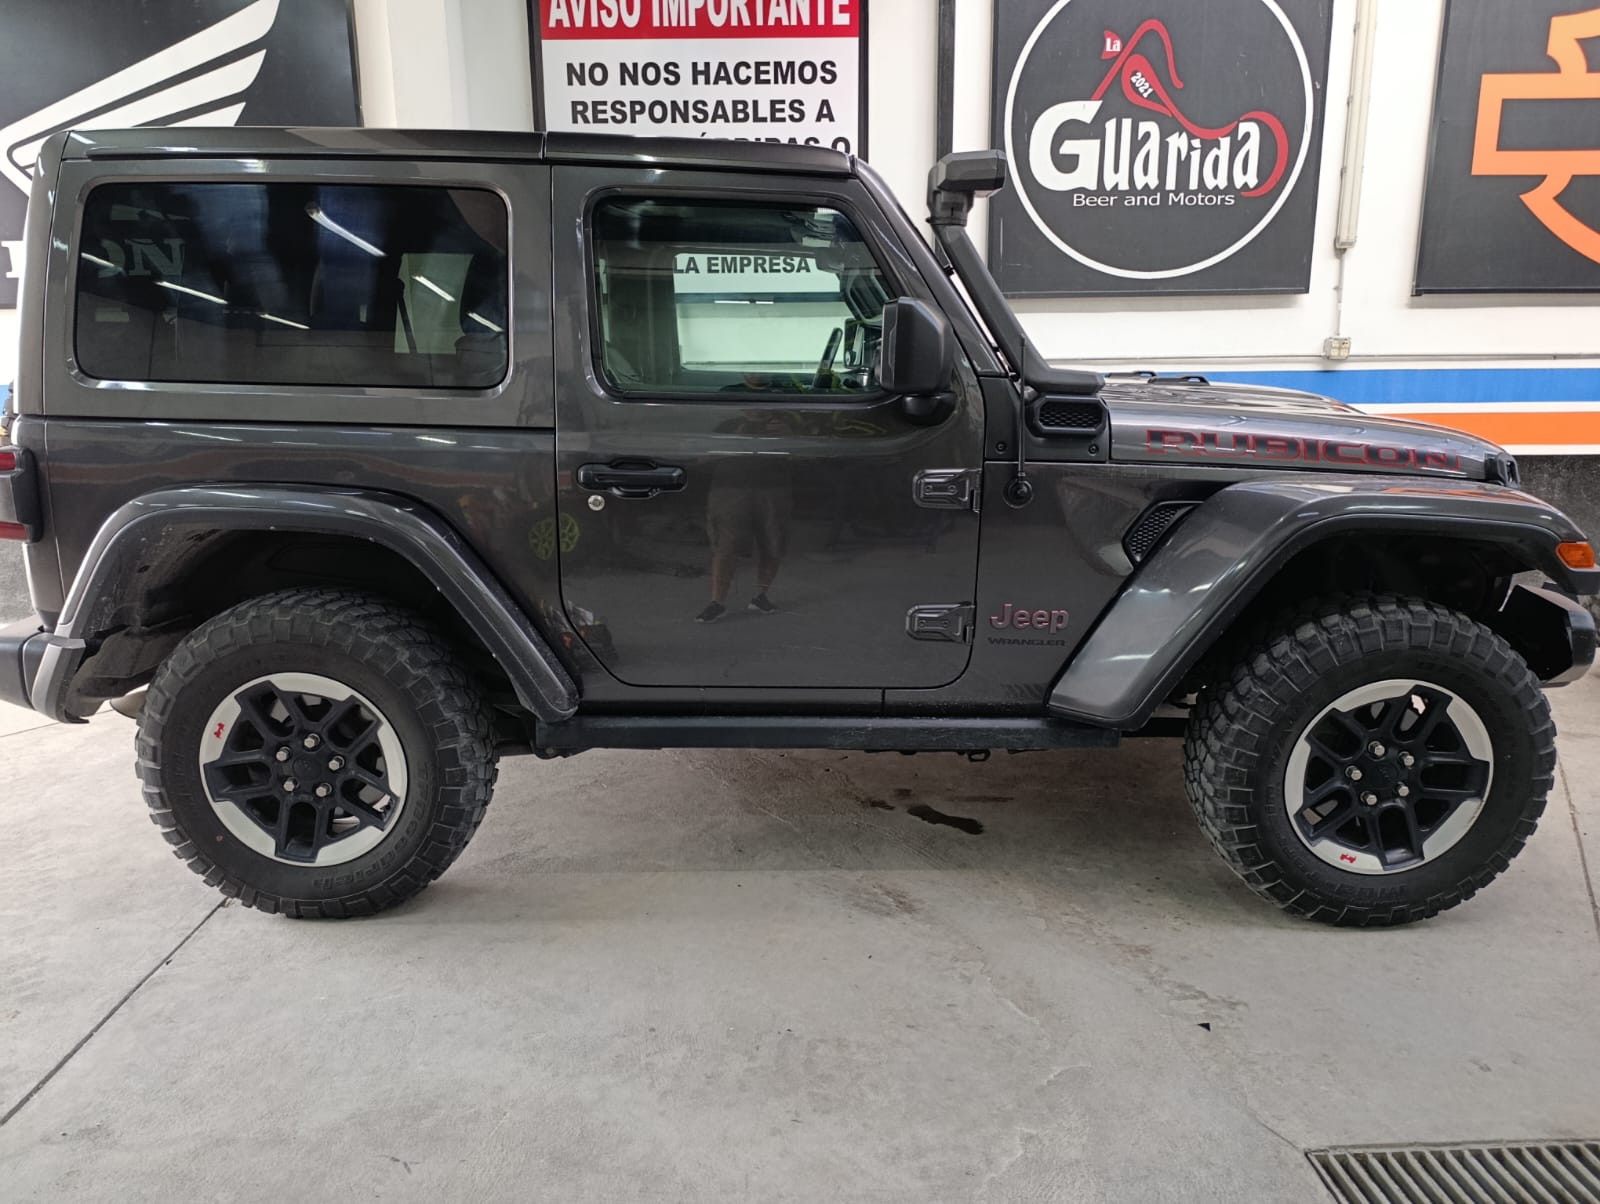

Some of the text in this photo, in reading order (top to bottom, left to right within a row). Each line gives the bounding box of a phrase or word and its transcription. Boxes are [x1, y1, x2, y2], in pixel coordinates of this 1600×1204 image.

[548, 0, 850, 28] AVISO IMPORTANTE
[1105, 37, 1121, 52] La
[566, 60, 838, 86] NO NOS HACEMOS
[1130, 71, 1153, 98] 2021
[571, 99, 836, 124] RESPONSABLES A
[1029, 100, 1260, 191] Guarida
[1073, 192, 1235, 207] Beer and Motors
[673, 256, 811, 274] LA EMPRESA
[1146, 429, 1461, 472] RUBICON
[990, 602, 1070, 635] Jeep
[988, 637, 1065, 647] WRANGLER
